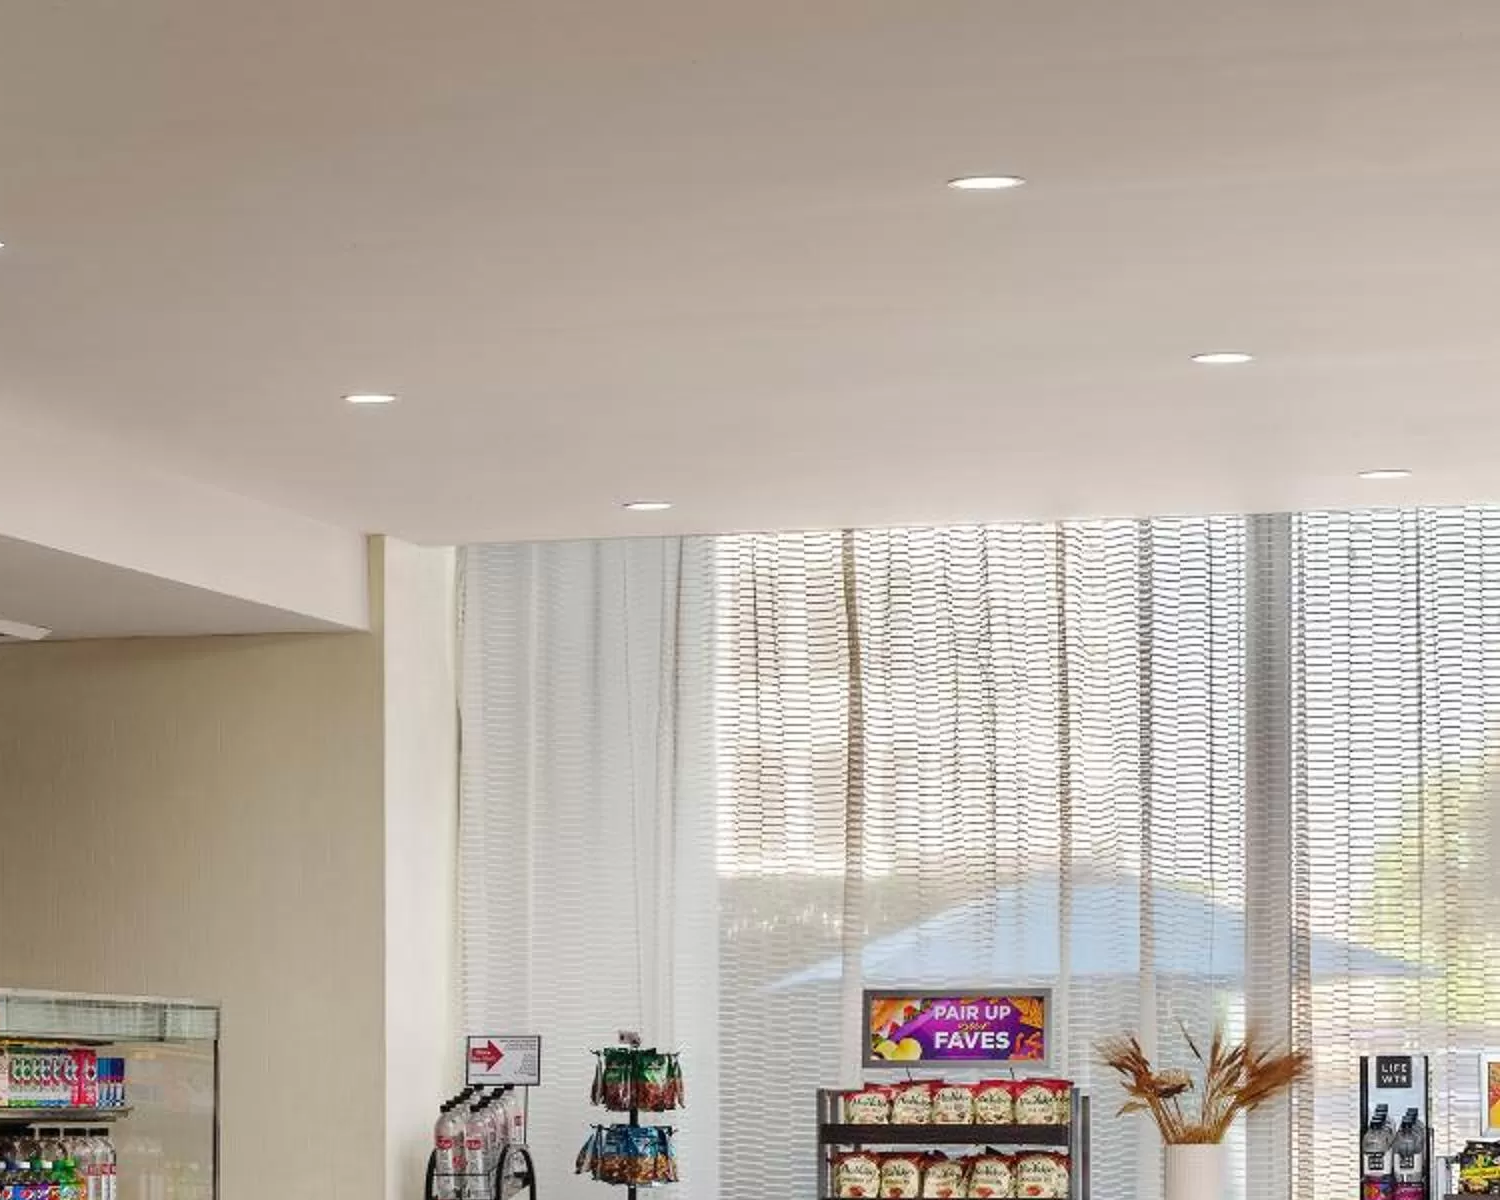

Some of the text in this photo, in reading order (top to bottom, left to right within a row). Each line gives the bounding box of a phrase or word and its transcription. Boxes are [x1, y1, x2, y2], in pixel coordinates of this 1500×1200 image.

[935, 1005, 1011, 1020] PAIR UP
[934, 1031, 1010, 1049] FAVES
[1381, 1063, 1408, 1073] LIFE
[1381, 1075, 1408, 1084] WTR
